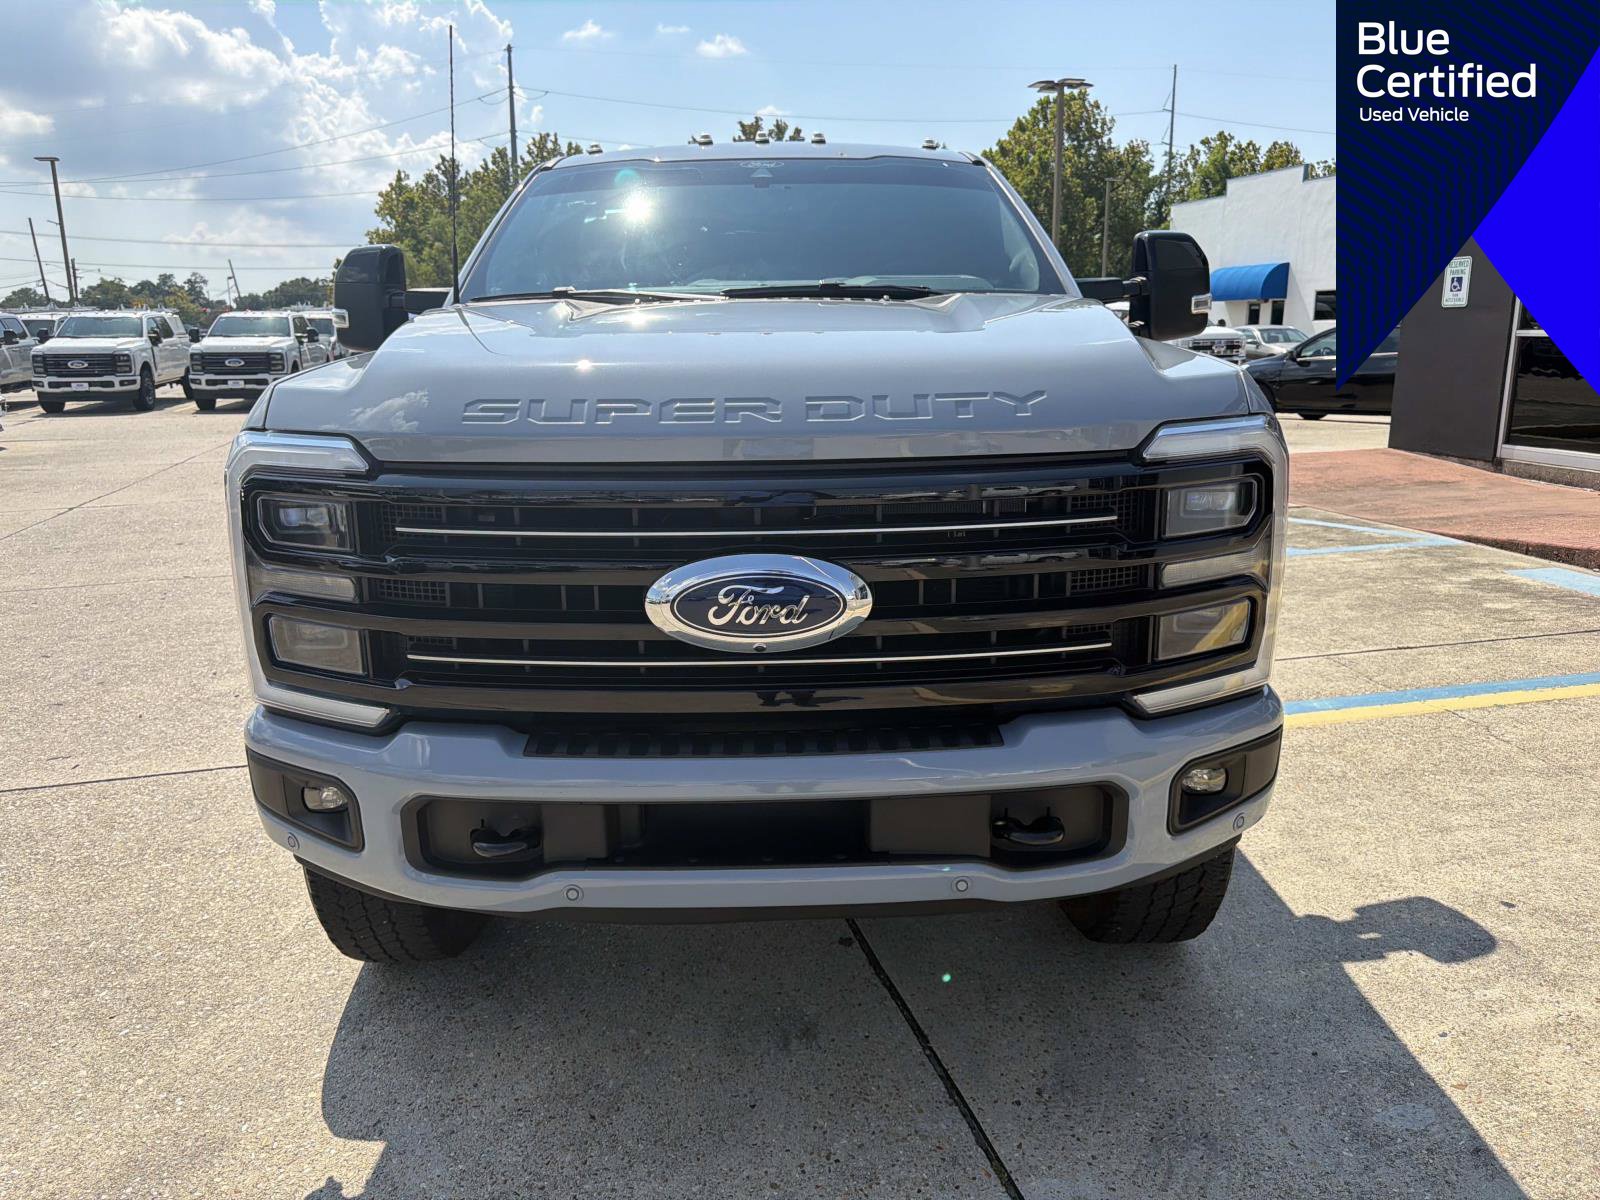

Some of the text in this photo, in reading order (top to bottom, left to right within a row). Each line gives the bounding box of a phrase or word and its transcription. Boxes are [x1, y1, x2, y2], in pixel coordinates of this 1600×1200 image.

[461, 390, 1047, 425] SUPER DUTY
[707, 584, 811, 626] Ford
